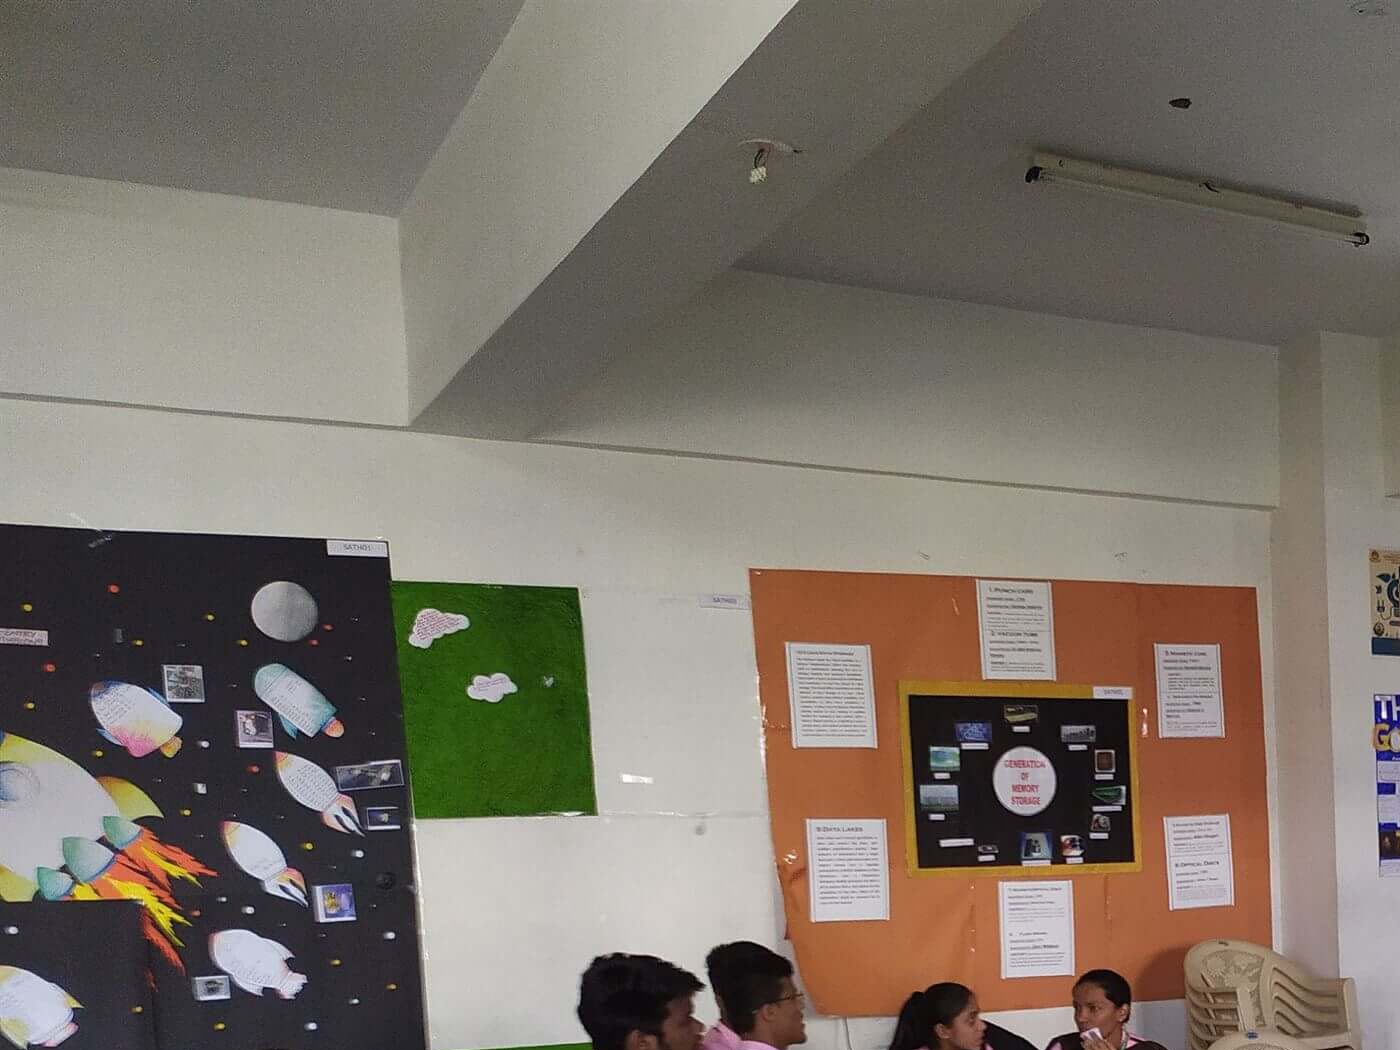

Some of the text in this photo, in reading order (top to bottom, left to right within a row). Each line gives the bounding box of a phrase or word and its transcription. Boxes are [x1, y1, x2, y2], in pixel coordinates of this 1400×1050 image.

[1004, 759, 1046, 768] GENERATION
[1021, 772, 1029, 780] OF
[1012, 784, 1040, 792] MEMORY
[1011, 796, 1041, 805] STORAGE
